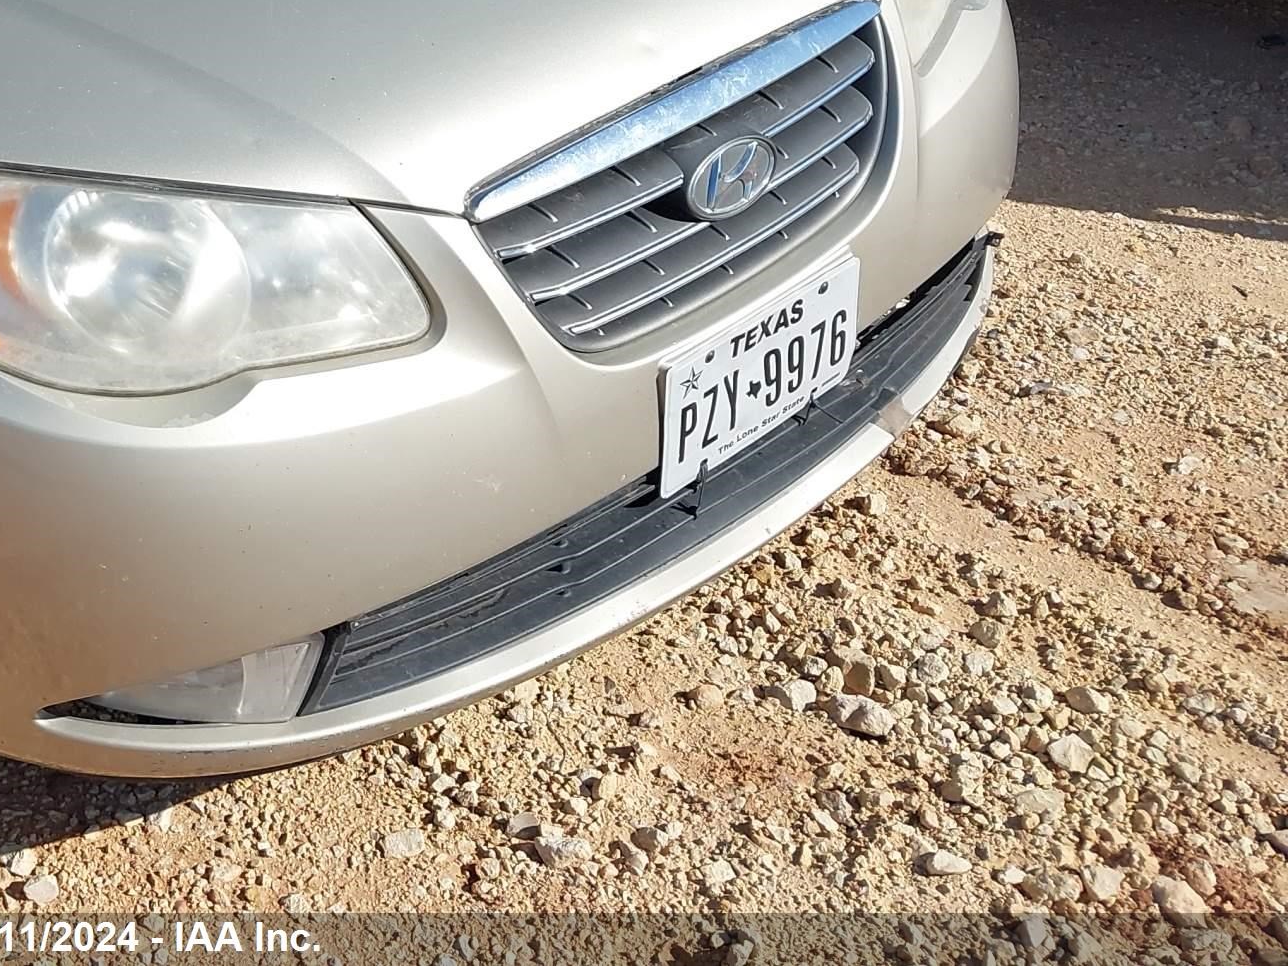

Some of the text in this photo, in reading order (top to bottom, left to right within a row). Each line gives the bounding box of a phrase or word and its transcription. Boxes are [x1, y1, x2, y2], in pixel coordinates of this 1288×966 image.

[730, 298, 805, 358] TEXAS
[717, 395, 806, 455] The Lone Star State
